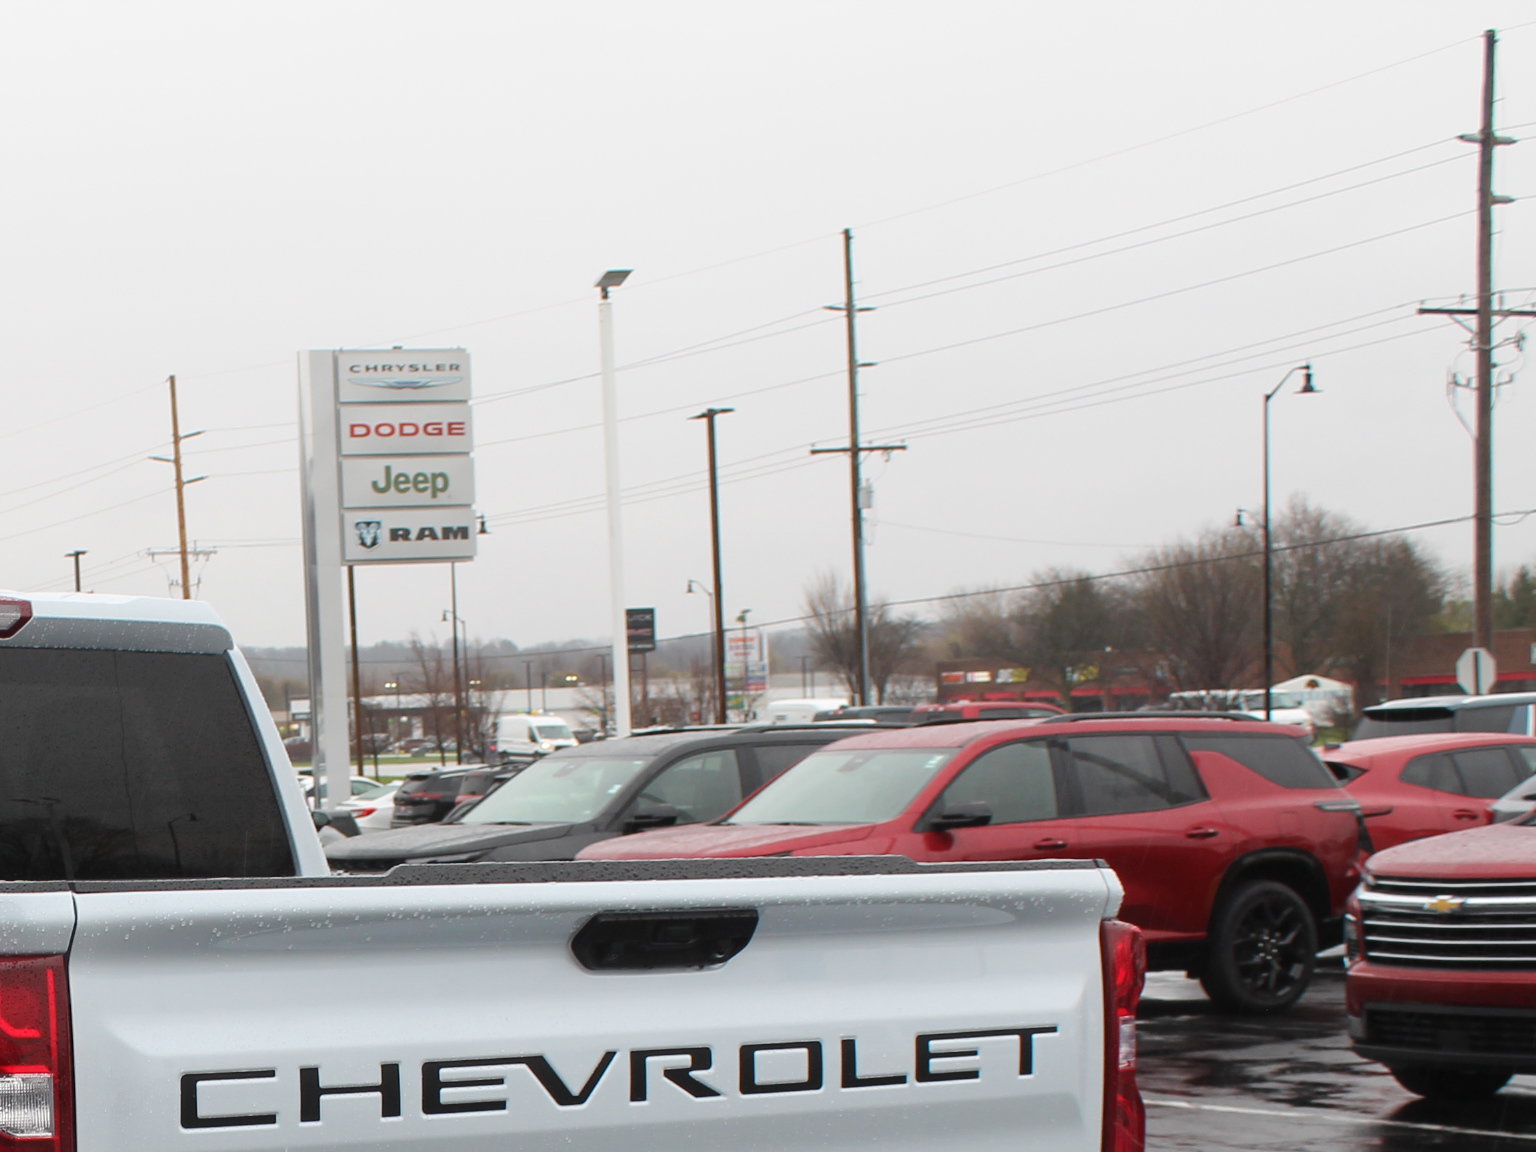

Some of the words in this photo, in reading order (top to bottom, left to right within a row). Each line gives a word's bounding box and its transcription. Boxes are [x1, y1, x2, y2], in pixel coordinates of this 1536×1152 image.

[349, 363, 461, 373] CHRYSLER
[349, 421, 466, 438] DODGE
[371, 465, 449, 498] Jeep
[389, 526, 470, 542] RAM
[180, 1025, 1059, 1129] CHEVROLET
